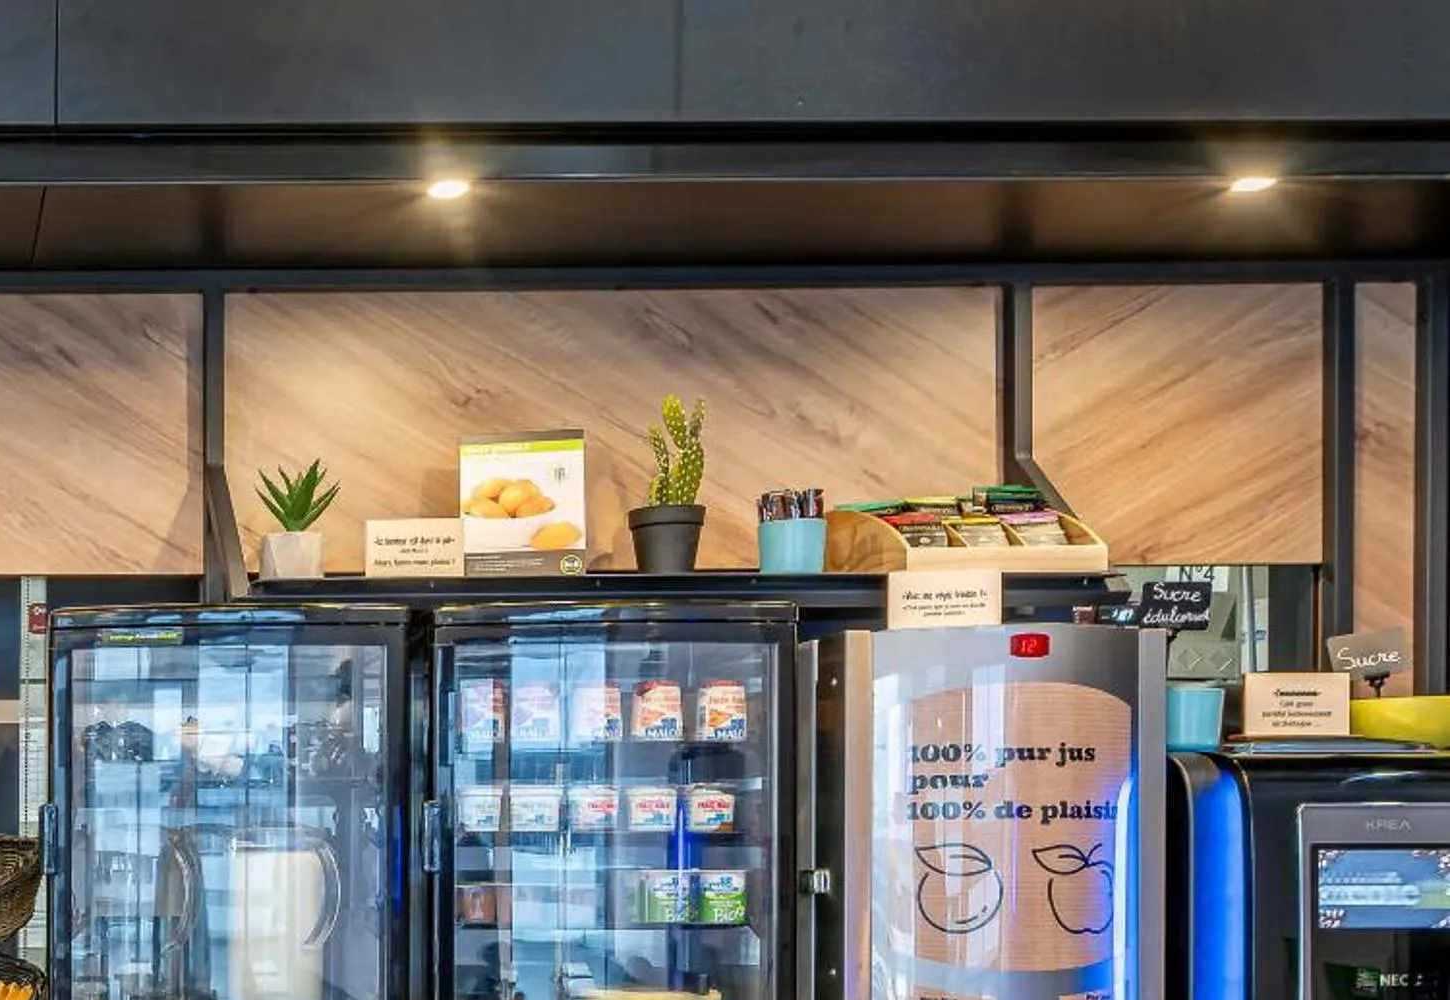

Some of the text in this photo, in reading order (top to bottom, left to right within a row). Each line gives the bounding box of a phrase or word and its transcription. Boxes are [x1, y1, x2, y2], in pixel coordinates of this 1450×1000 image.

[1153, 577, 1201, 602] Sucre
[1337, 646, 1401, 670] Sucre
[907, 742, 1096, 768] 100% pur jus
[908, 773, 989, 795] pour
[906, 801, 986, 820] 100%
[994, 801, 1033, 820] de
